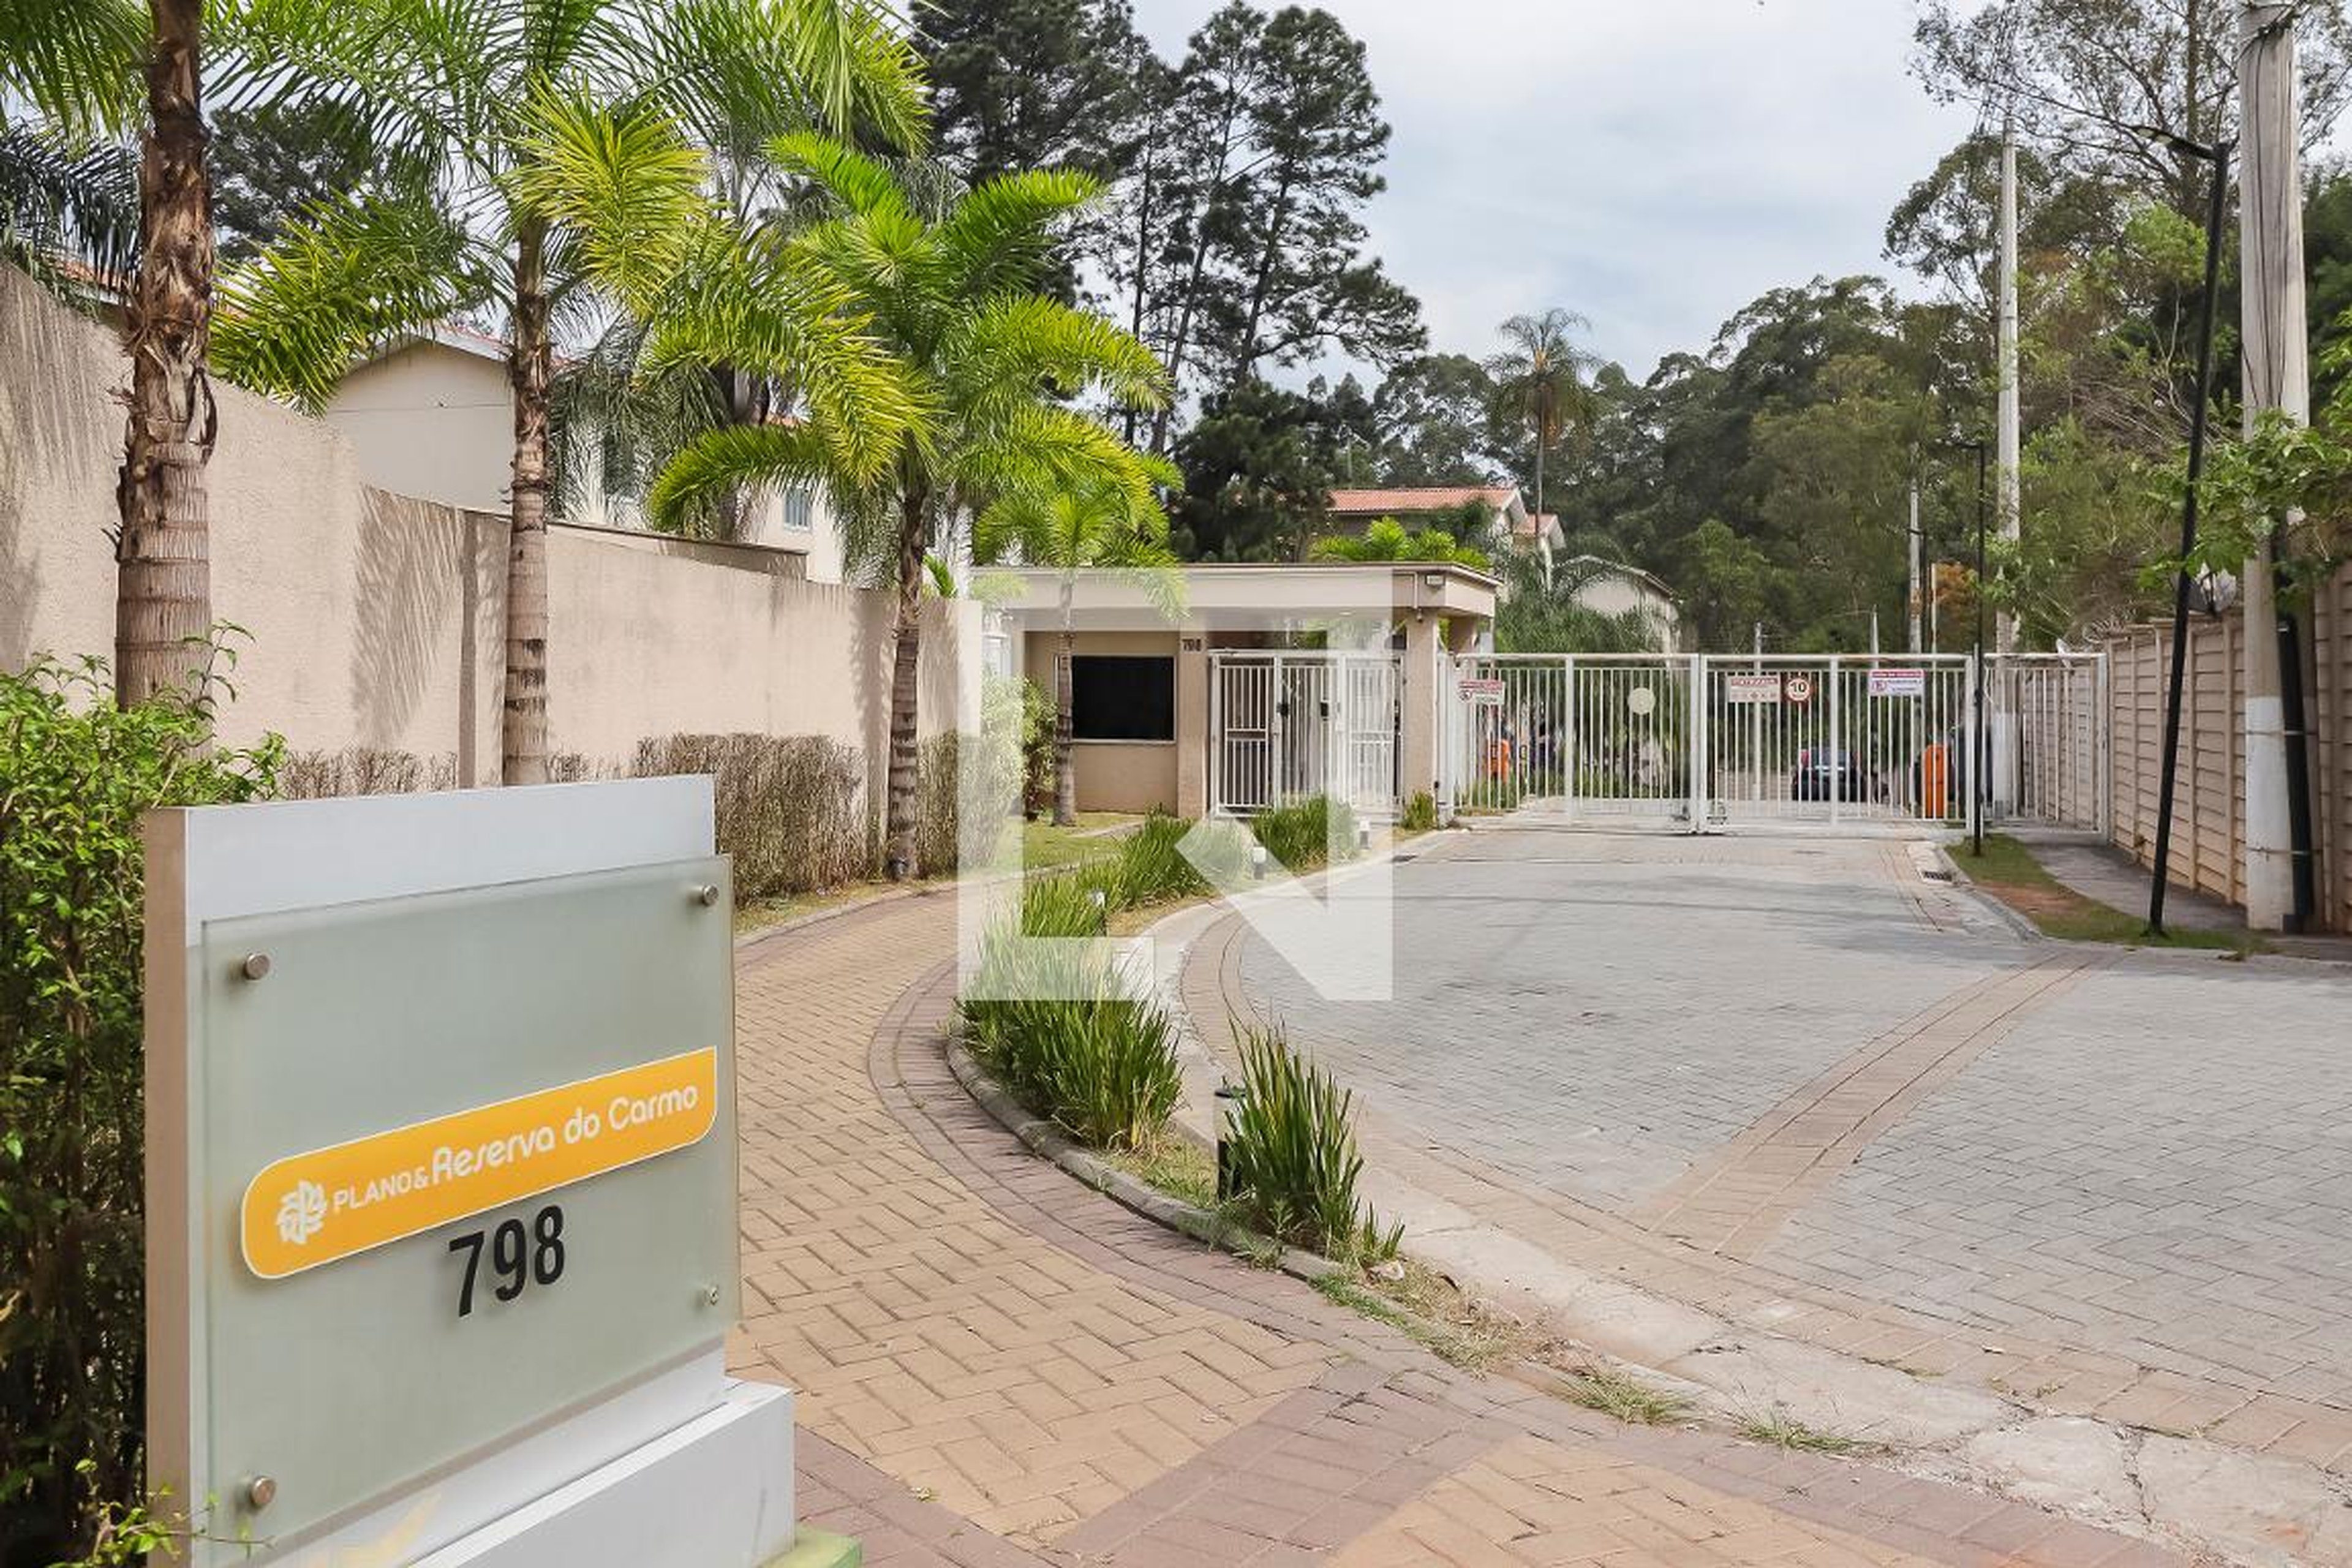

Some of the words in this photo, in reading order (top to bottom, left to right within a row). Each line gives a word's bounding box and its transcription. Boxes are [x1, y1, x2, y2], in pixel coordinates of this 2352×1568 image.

[1790, 681, 1806, 693] 10
[432, 1125, 556, 1185] Reserva
[563, 1107, 601, 1145] do
[608, 1085, 698, 1131] Carmo
[449, 1205, 565, 1317] 798
